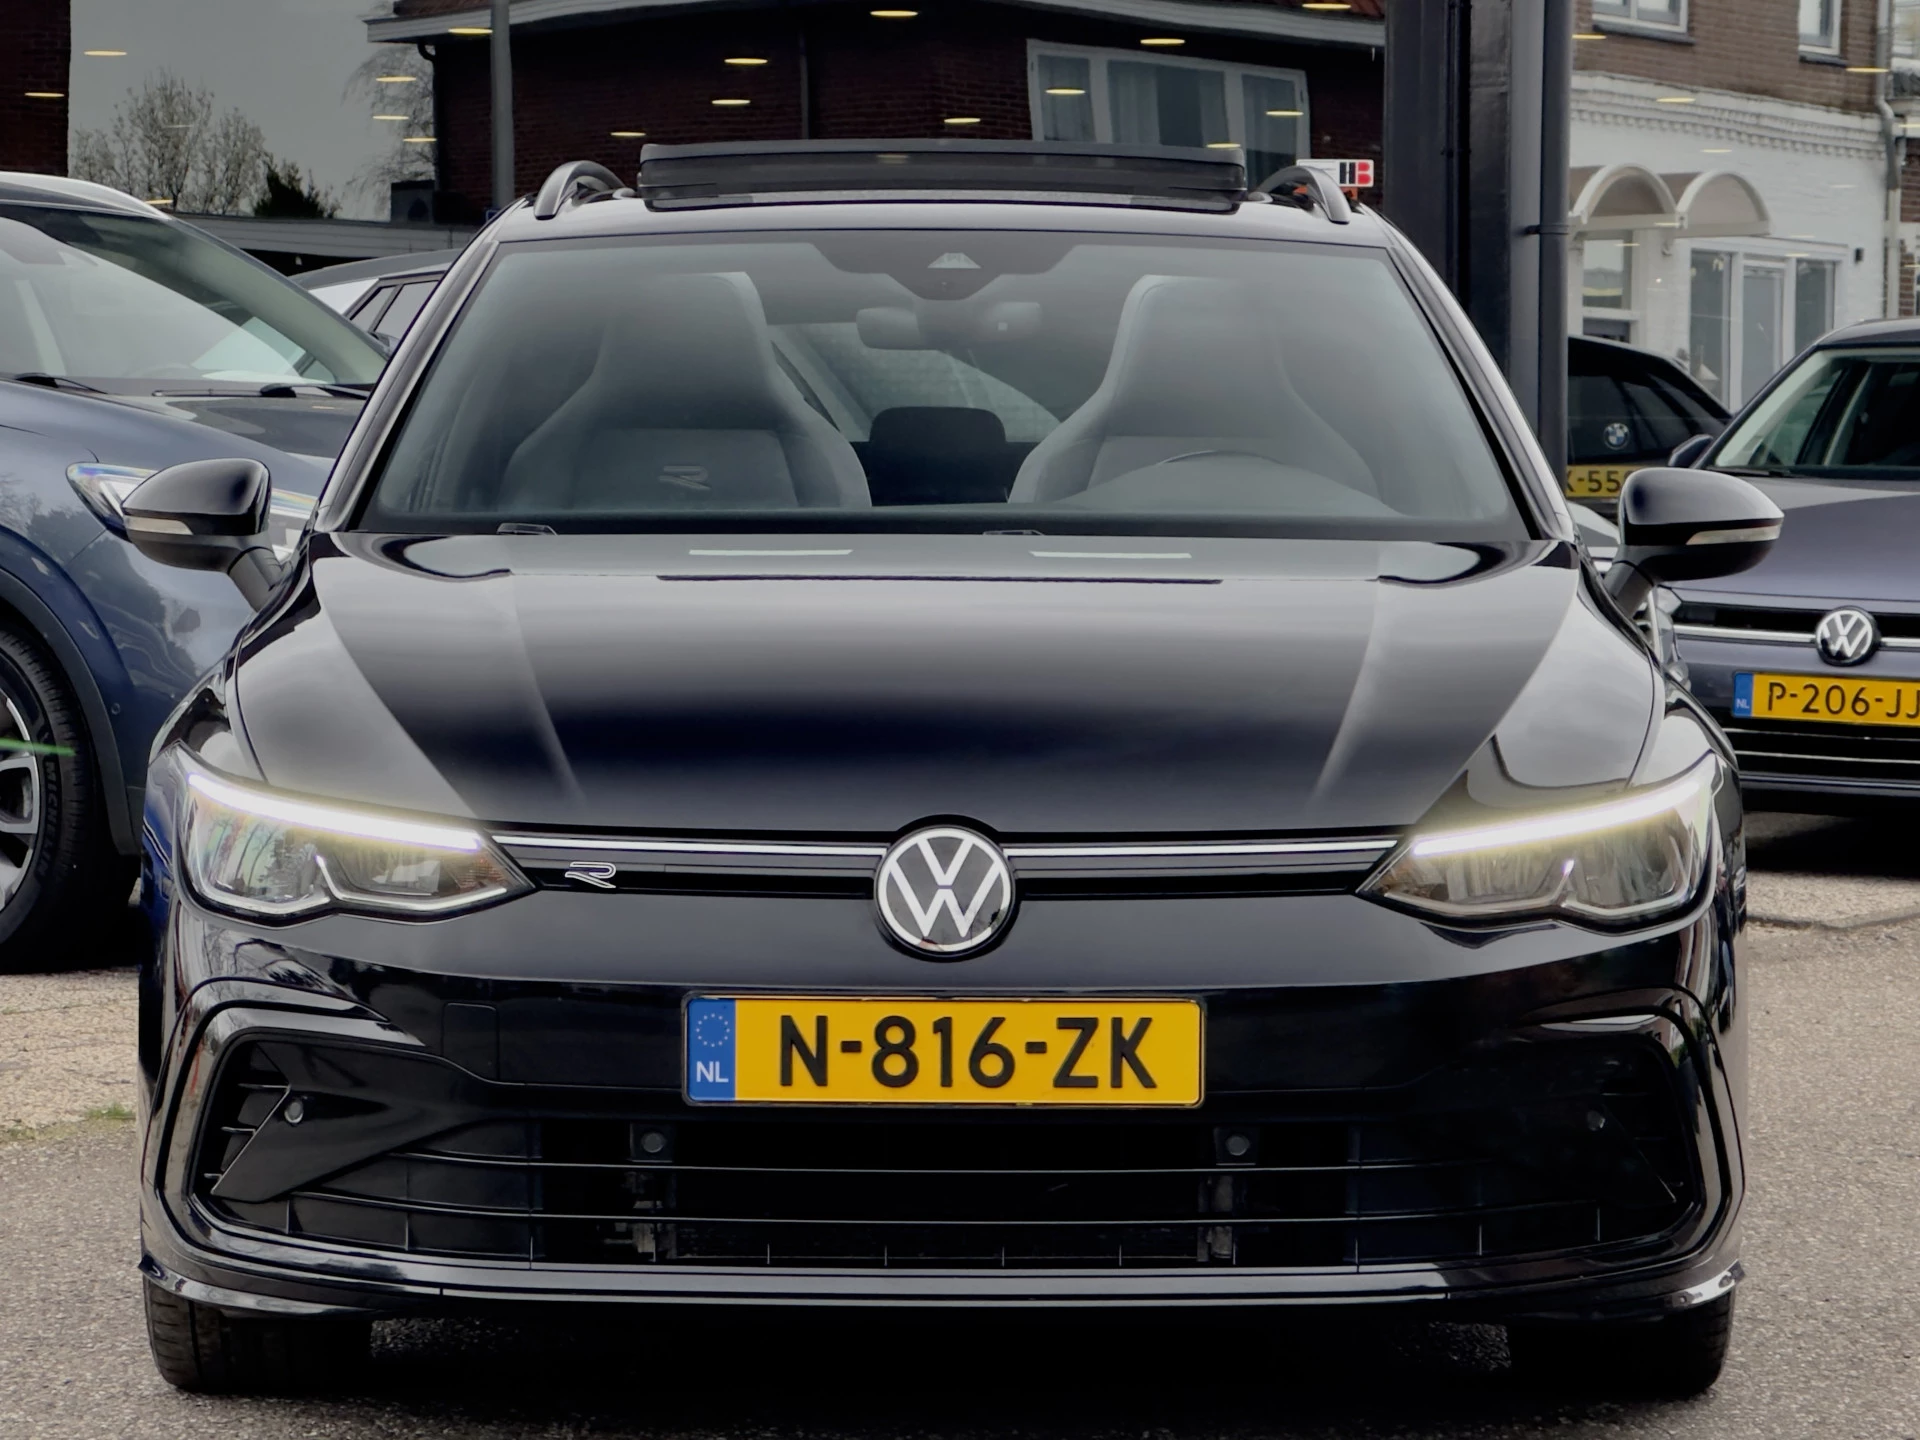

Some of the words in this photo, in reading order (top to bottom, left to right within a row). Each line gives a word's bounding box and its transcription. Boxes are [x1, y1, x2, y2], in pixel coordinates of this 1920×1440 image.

[1736, 697, 1750, 709] NL
[1768, 682, 1920, 719] P-206-JJ
[779, 1014, 1157, 1089] N-816-ZK
[696, 1061, 729, 1083] NL
